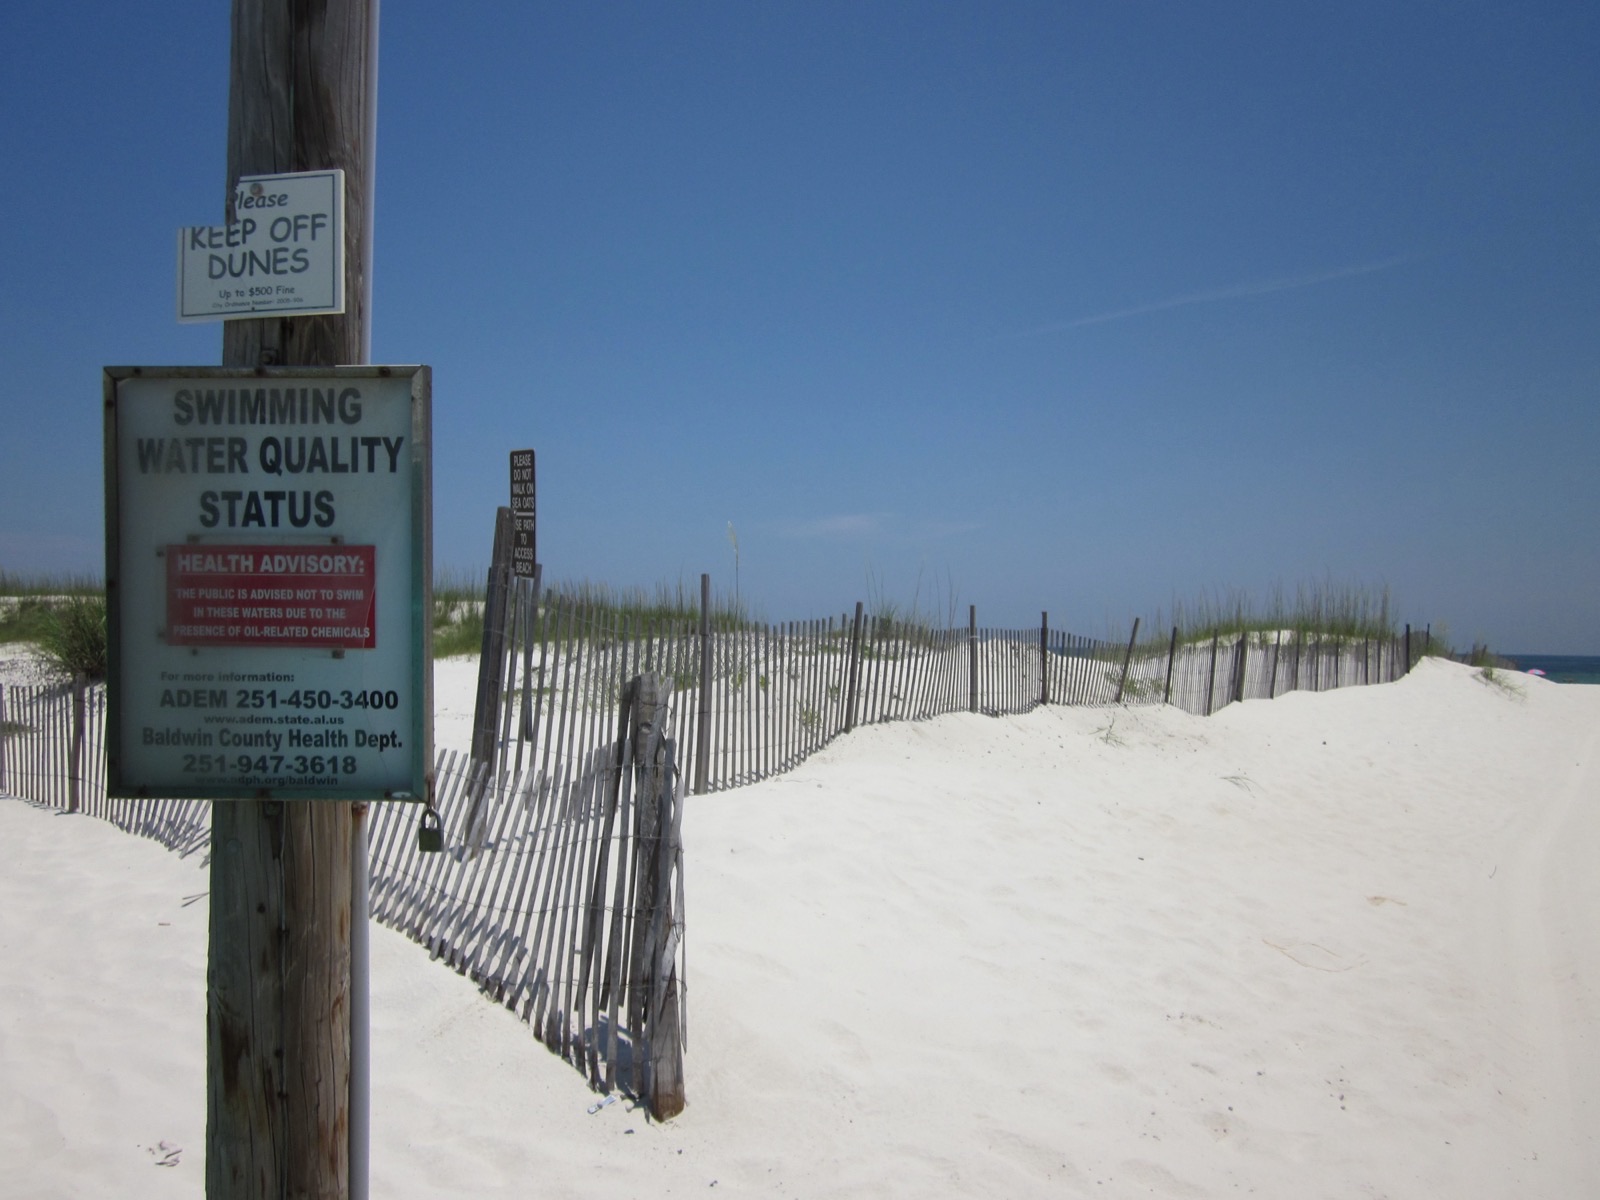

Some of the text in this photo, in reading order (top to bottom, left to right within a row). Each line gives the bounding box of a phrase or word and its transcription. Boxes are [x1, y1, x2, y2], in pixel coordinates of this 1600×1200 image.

[237, 191, 288, 210] lease
[191, 213, 328, 250] KEEP OFF
[208, 247, 310, 280] DUNES
[219, 285, 295, 299] Up to $500 Fine
[173, 387, 362, 426] SWIMMING
[137, 436, 404, 476] WATER QUALITY
[513, 453, 531, 467] PLEASE
[513, 468, 532, 481] DO NOT
[512, 482, 534, 495] WALK ON
[199, 490, 336, 528] STATUS
[512, 496, 535, 509] SEA OATS
[523, 519, 535, 531] PATH
[520, 533, 527, 545] TO
[514, 547, 533, 560] ACCESS
[177, 554, 365, 574] HEALTH ADVISORY:
[516, 561, 531, 574] BEACH
[176, 588, 364, 601] THE PUBLIC IS ADVISED NOT TO SWIM
[193, 607, 346, 619] IN THESE WATERS DUE TO THE
[173, 625, 370, 639] PRESENCE OF OIL-RELATED CHEMICALS
[160, 671, 294, 683] For more information:
[160, 689, 399, 710] ADEM 251-450-3400
[203, 714, 344, 725] www.adem.state.al.us
[142, 727, 403, 752] Baldwin County Health Dept.
[182, 754, 357, 774] 251-947-3618
[195, 774, 338, 787] www.adph.org/baldwin
